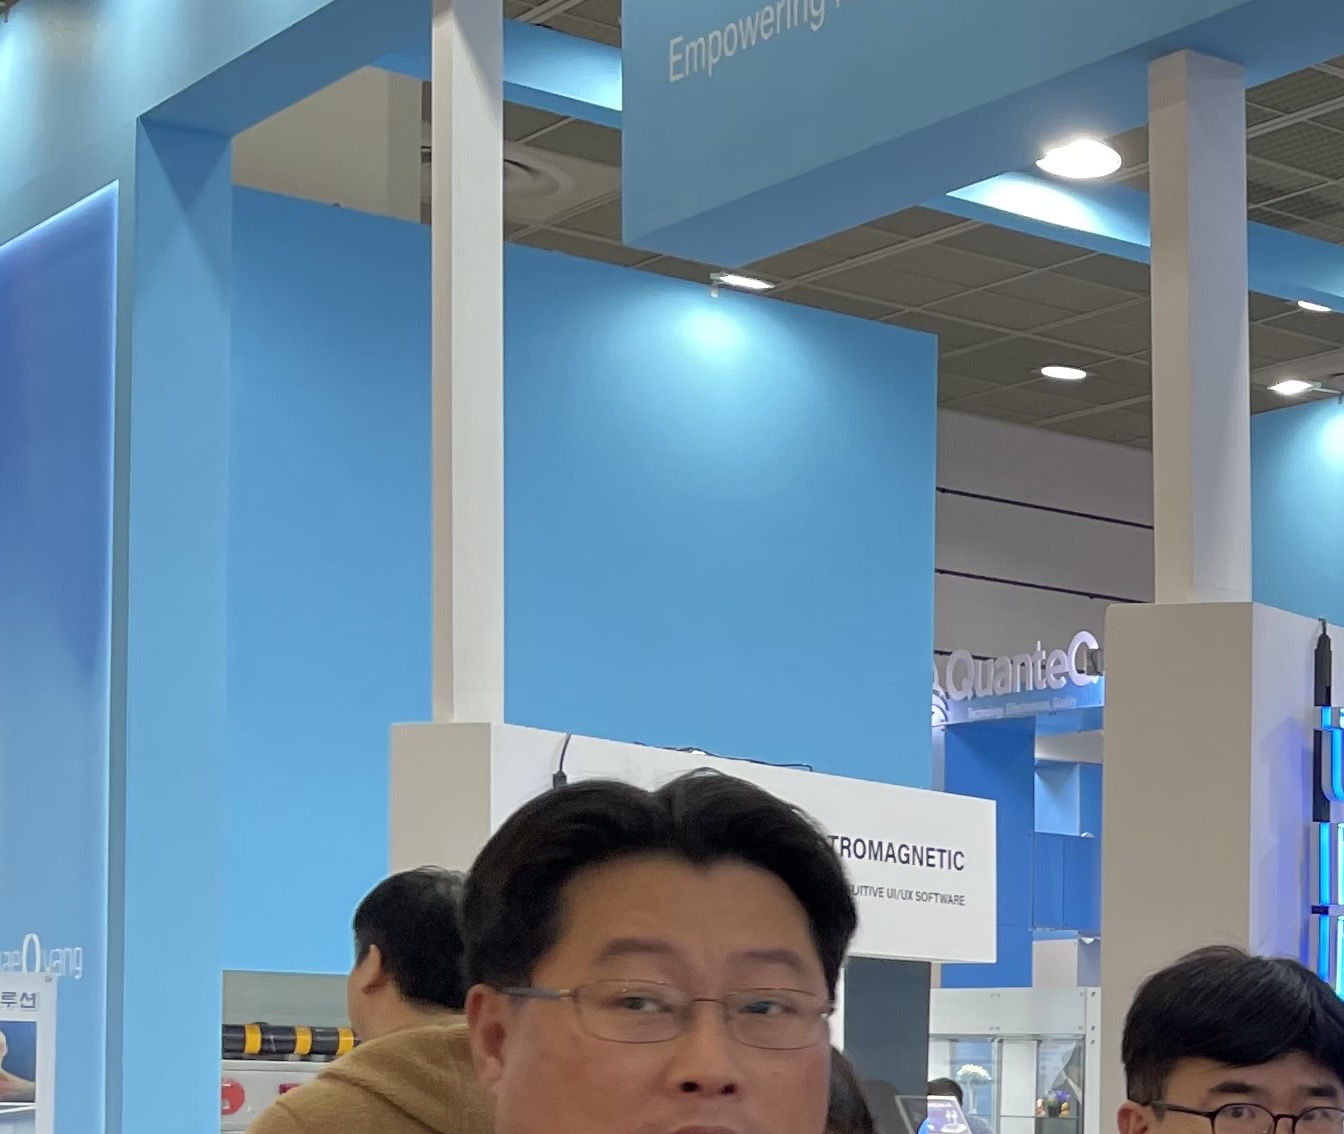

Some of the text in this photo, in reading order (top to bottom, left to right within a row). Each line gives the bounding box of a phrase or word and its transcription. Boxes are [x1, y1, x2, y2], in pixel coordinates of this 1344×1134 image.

[669, 0, 826, 82] Empowering
[850, 884, 884, 899] UITIVE
[915, 891, 966, 907] SOFTWARE
